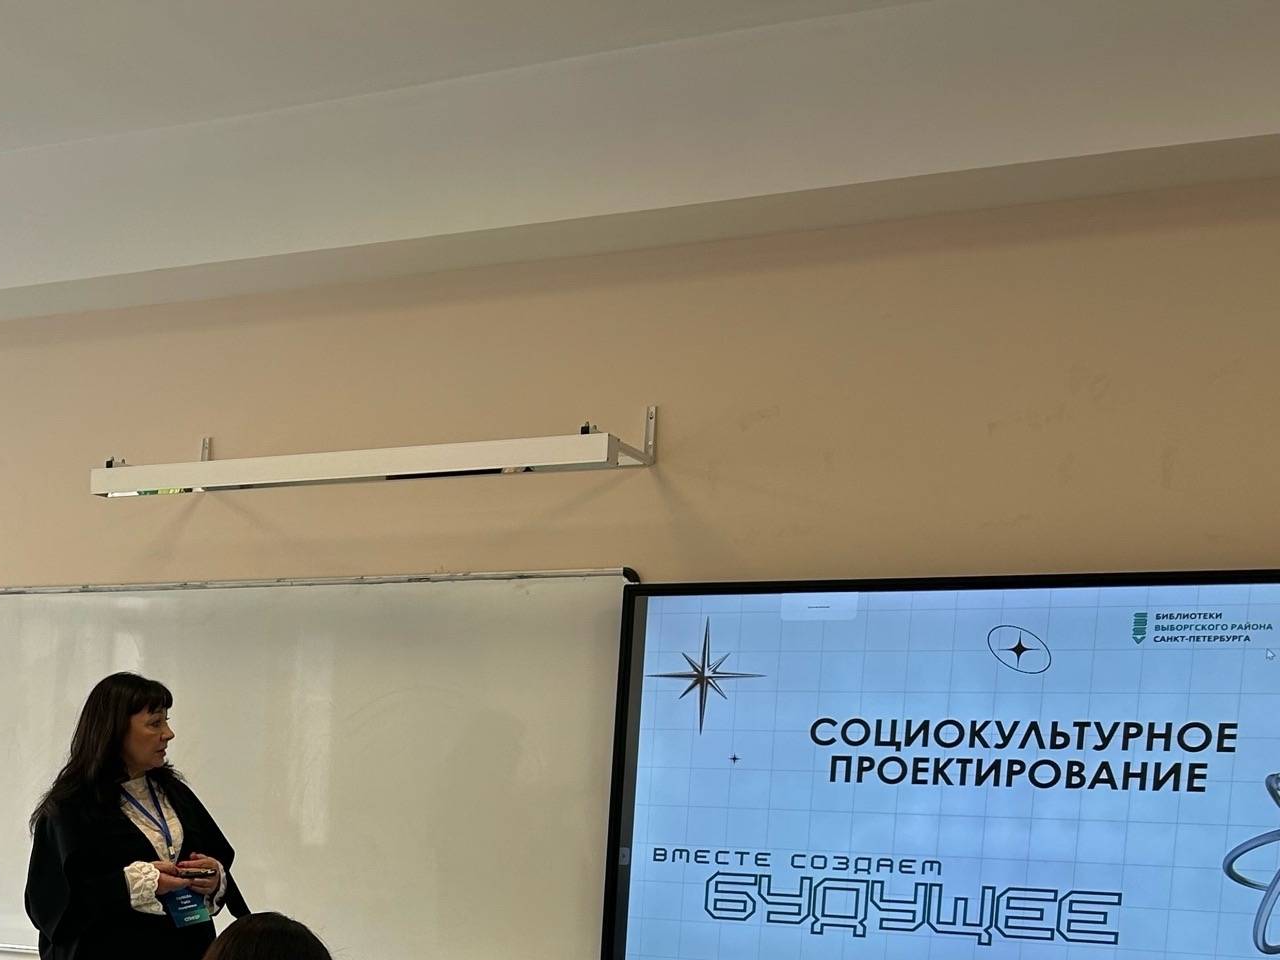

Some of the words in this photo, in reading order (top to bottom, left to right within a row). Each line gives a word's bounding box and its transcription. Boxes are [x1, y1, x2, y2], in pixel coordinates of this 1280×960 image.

[1154, 623, 1228, 632] ВЫБОРГСКОГО
[1231, 621, 1273, 631] РАЙОНА
[1155, 612, 1222, 620] БИБЛИОТЕКИ
[1153, 635, 1251, 643] САНКТ-ПЕТЕРБУРГА
[810, 717, 1239, 754] СОЦИОКУЛЬТУРНОЕ
[829, 755, 1209, 793] ПРОЕКТИРОВАНИЕ
[652, 847, 771, 868] ВМЕСТЕ
[790, 853, 943, 876] СОЗДАЕМ
[704, 871, 1123, 946] БУДУЩЕЕ
